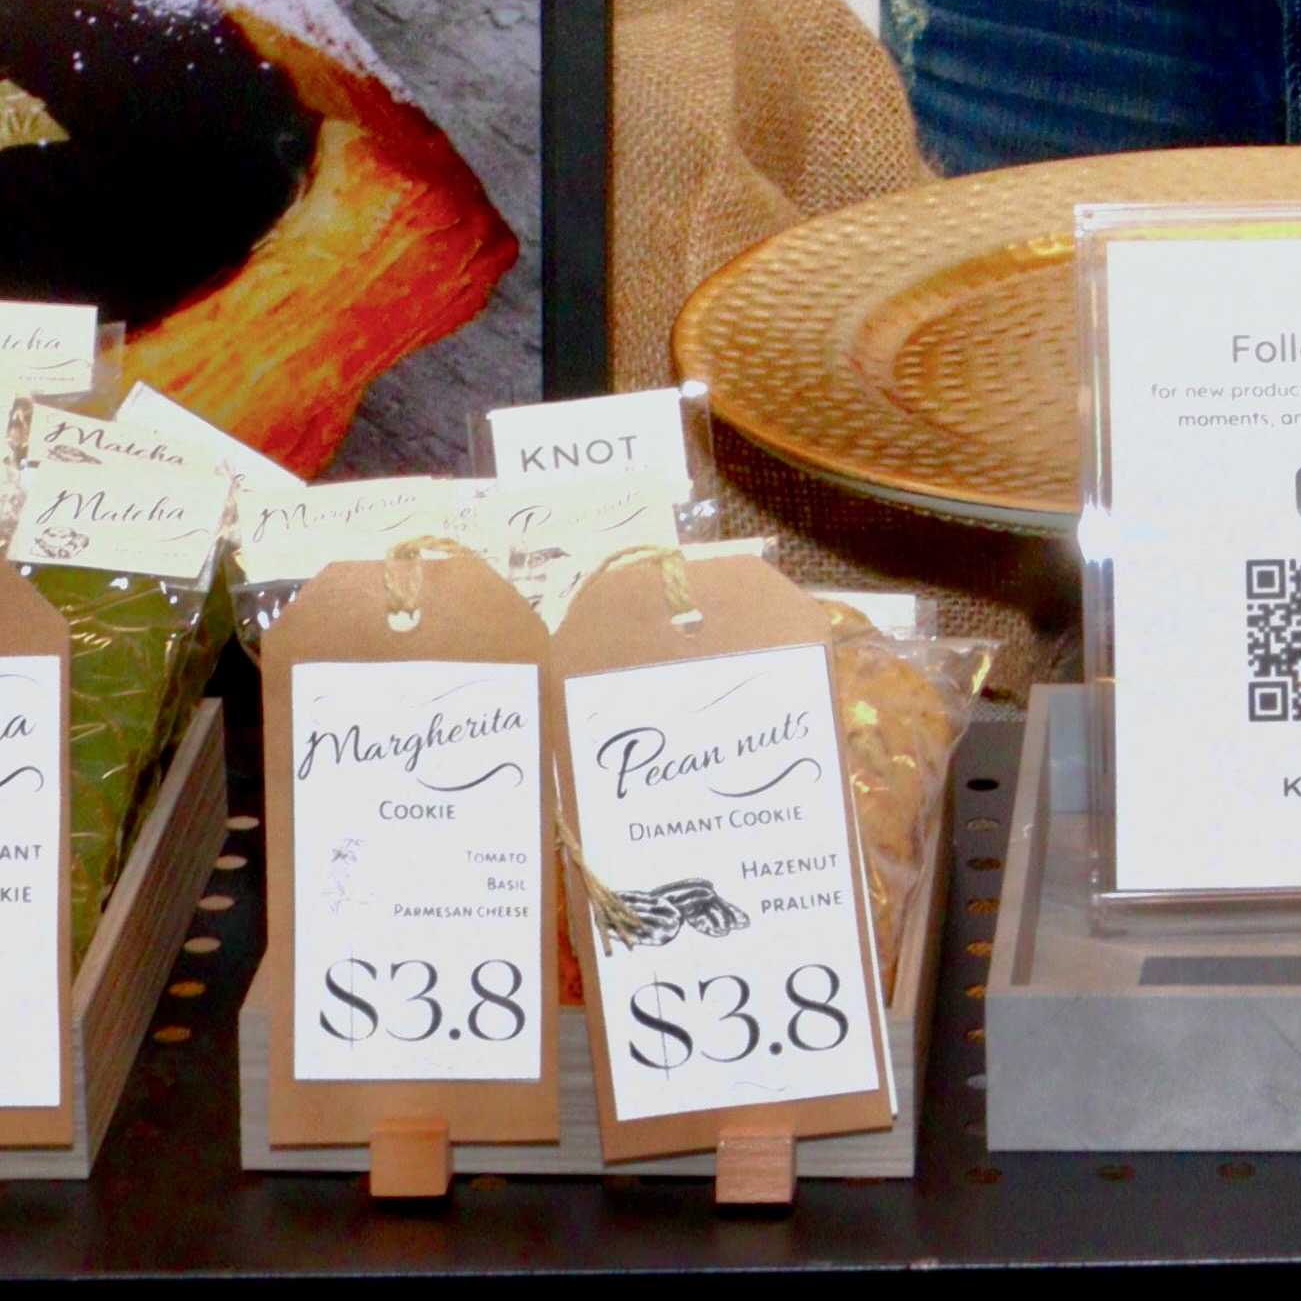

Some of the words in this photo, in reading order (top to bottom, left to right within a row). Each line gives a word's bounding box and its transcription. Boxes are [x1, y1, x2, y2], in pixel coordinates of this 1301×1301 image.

[1151, 384, 1178, 399] for
[1185, 385, 1225, 398] new
[44, 421, 184, 466] Matcha
[521, 435, 637, 472] KNOT
[36, 489, 185, 525] Matcha
[297, 707, 526, 781] Margherita
[596, 726, 725, 799] Pecan
[737, 710, 810, 758] nuts
[379, 800, 456, 820] COOKIE
[629, 815, 723, 842] DIAMANT
[729, 805, 804, 829] COOKIE
[466, 849, 527, 865] TOMATO
[742, 852, 839, 880] HAZENUT
[487, 877, 526, 892] BASIL
[761, 889, 844, 914] PRALINE
[393, 904, 472, 919] PARMESAN
[477, 904, 529, 918] CHEESE
[319, 955, 526, 1044] $3.8
[628, 963, 849, 1074] $3.8
